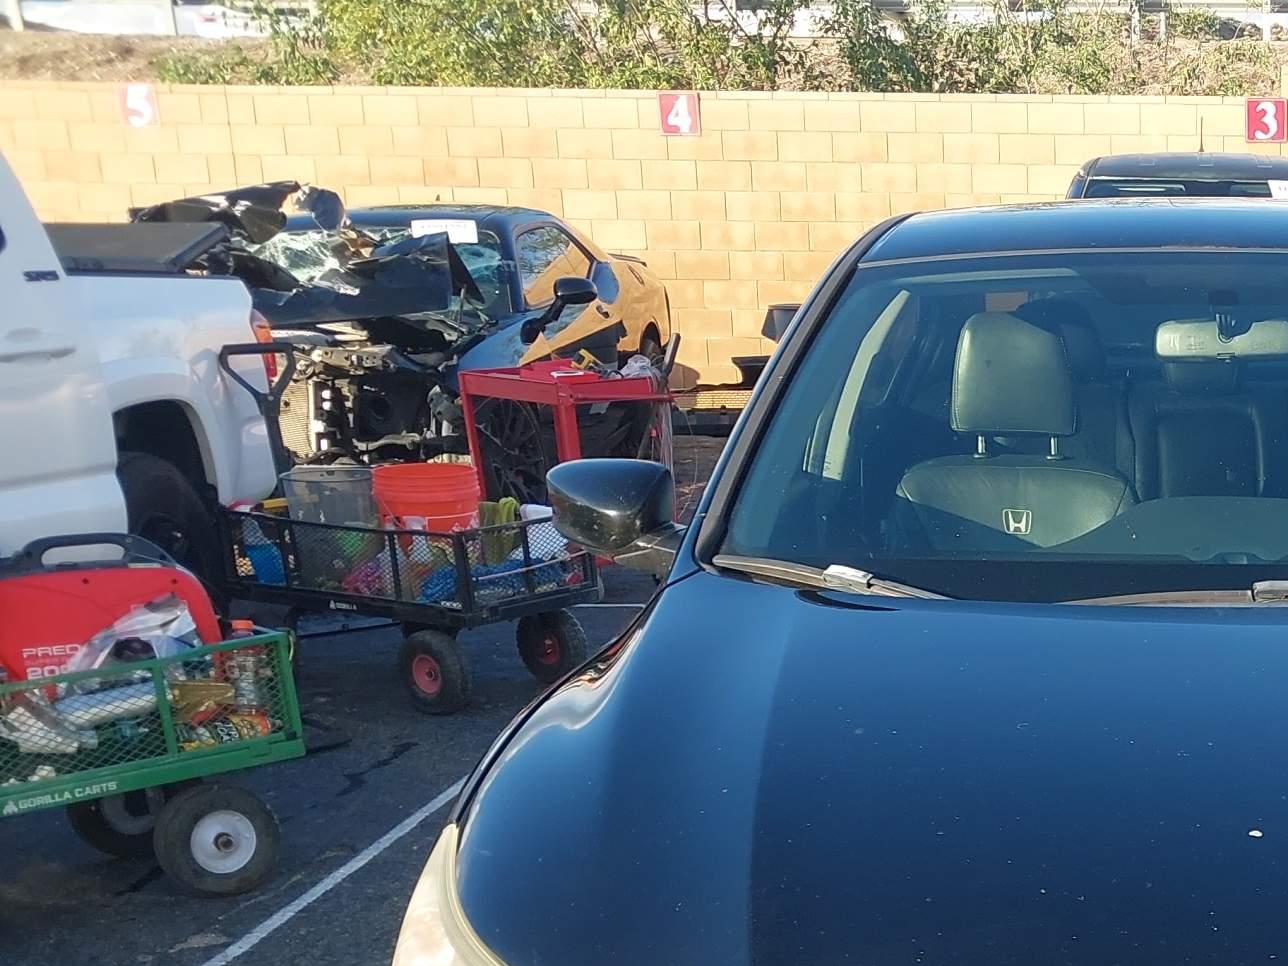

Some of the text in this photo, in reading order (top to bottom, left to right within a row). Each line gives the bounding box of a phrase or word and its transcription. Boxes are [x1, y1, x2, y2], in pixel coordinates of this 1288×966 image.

[127, 85, 153, 128] 5
[667, 94, 692, 133] 4
[1254, 100, 1278, 140] 3
[22, 643, 81, 659] PRED
[26, 664, 70, 681] 200
[18, 781, 118, 809] GORILLA CARTS
